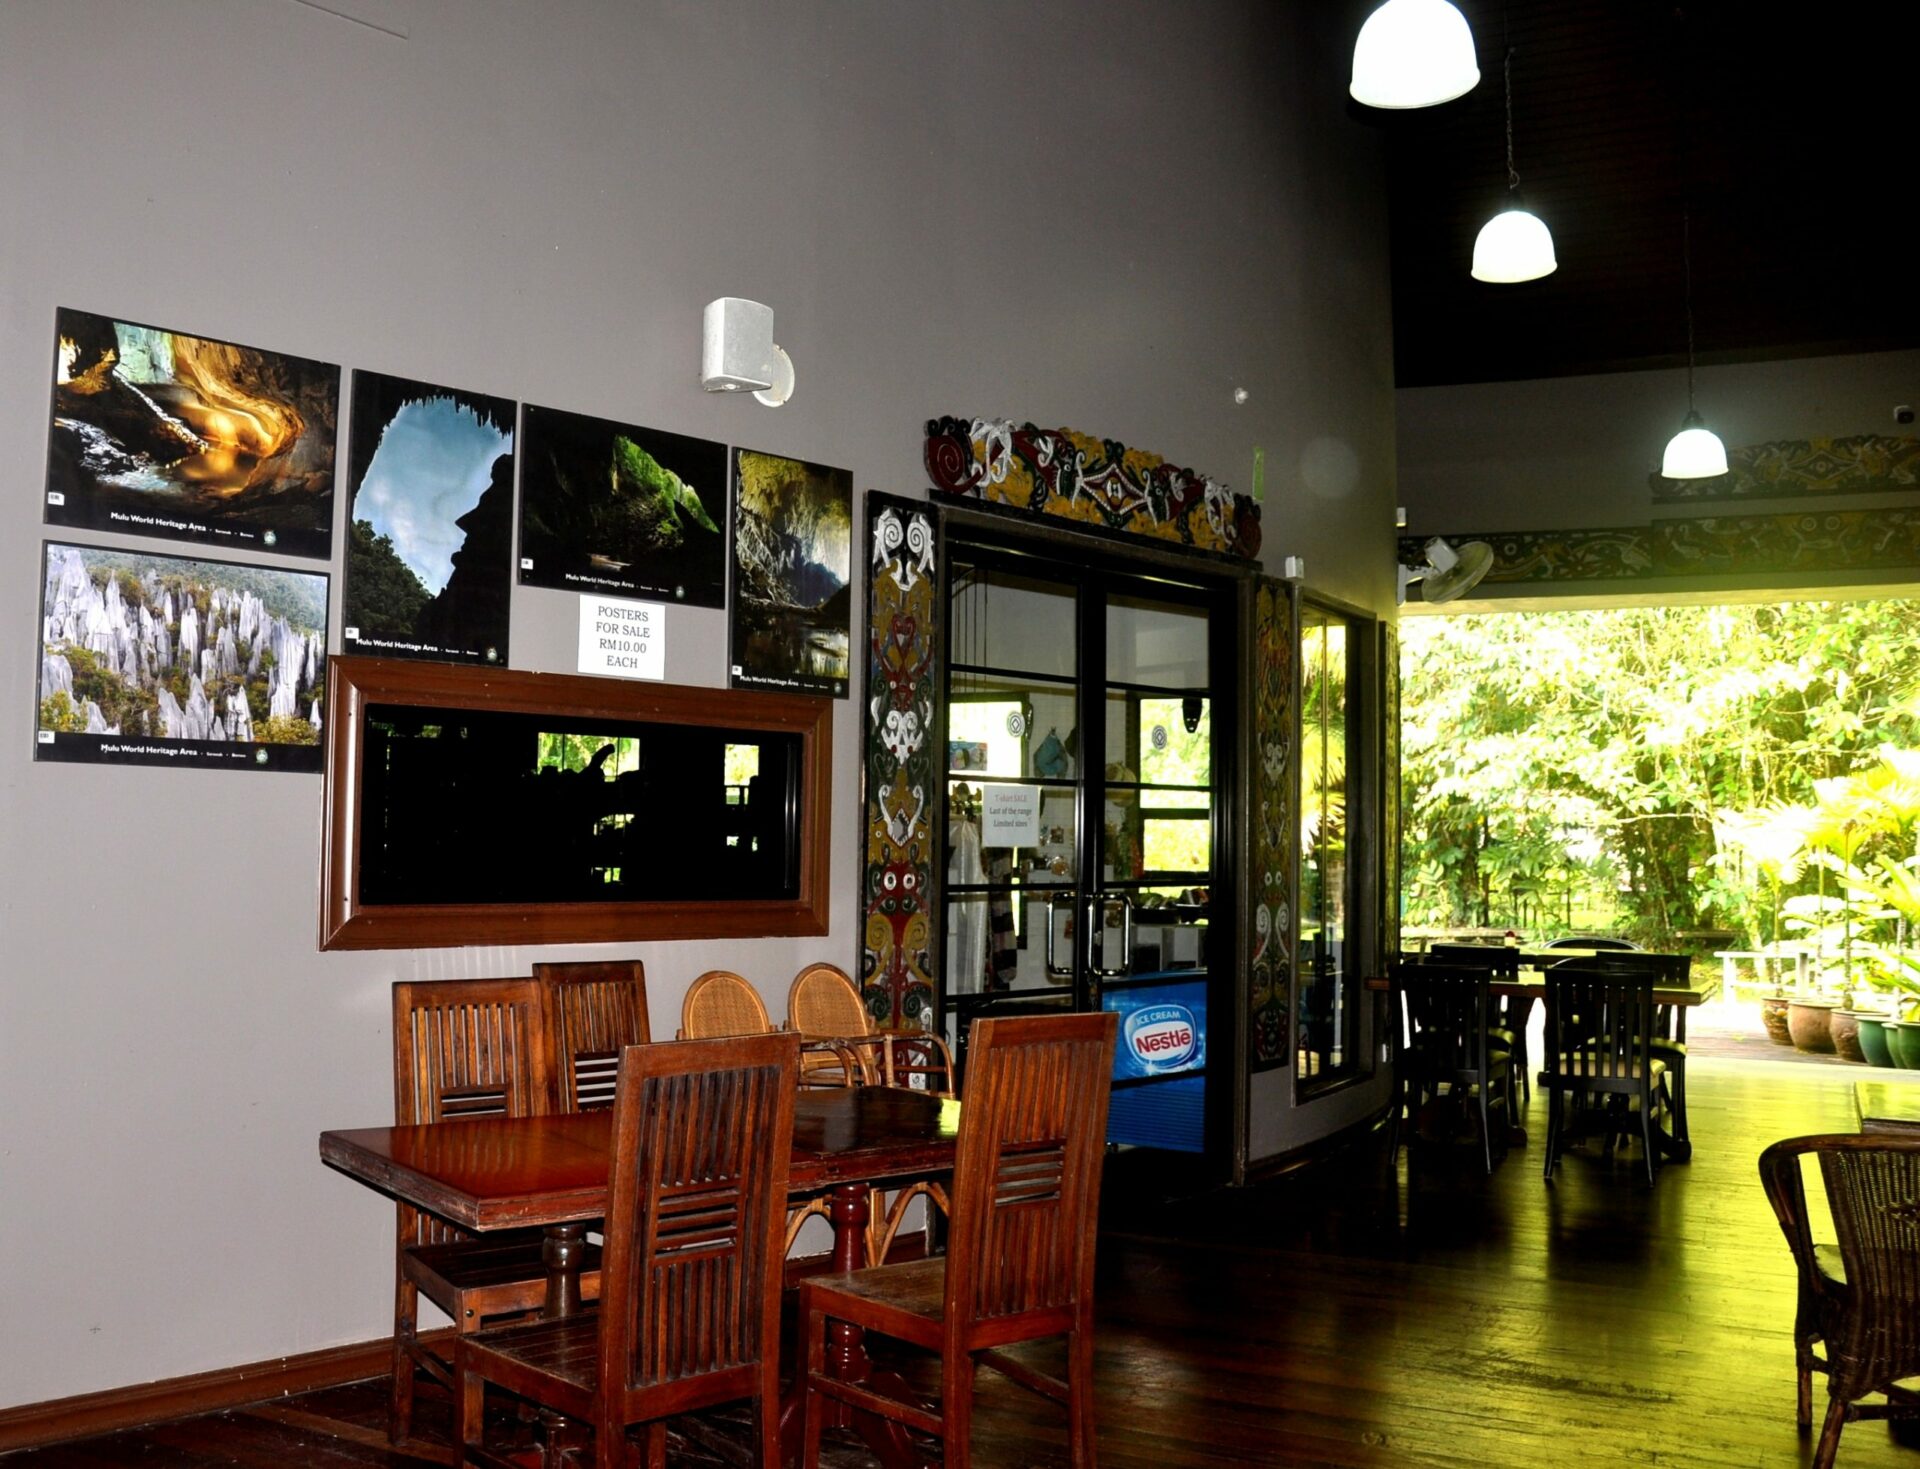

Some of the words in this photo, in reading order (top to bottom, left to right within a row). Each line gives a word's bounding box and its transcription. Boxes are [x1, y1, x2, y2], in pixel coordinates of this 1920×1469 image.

[110, 512, 130, 522] Mulu
[130, 515, 154, 524] World
[156, 518, 187, 530] Heritage
[188, 522, 206, 532] Area
[565, 573, 580, 581] Mulu
[597, 578, 620, 587] Heritage
[621, 580, 634, 588] Area
[598, 605, 649, 622] POSTERS
[596, 621, 619, 635] FOR
[622, 624, 650, 638] SALE
[356, 638, 372, 646] Mulu
[373, 640, 393, 648] World
[394, 642, 422, 652] Heritage
[422, 644, 438, 652] Area
[599, 638, 647, 654] RM10.00
[607, 655, 638, 669] EACH
[767, 678, 787, 686] Heritage
[100, 744, 120, 752] Mulu
[120, 745, 144, 753] World
[146, 746, 178, 756] Heritage
[180, 748, 197, 756] Area
[1008, 807, 1016, 815] the
[1018, 808, 1032, 816] range
[1135, 1014, 1150, 1025] ICE
[1150, 1011, 1181, 1021] CREAM
